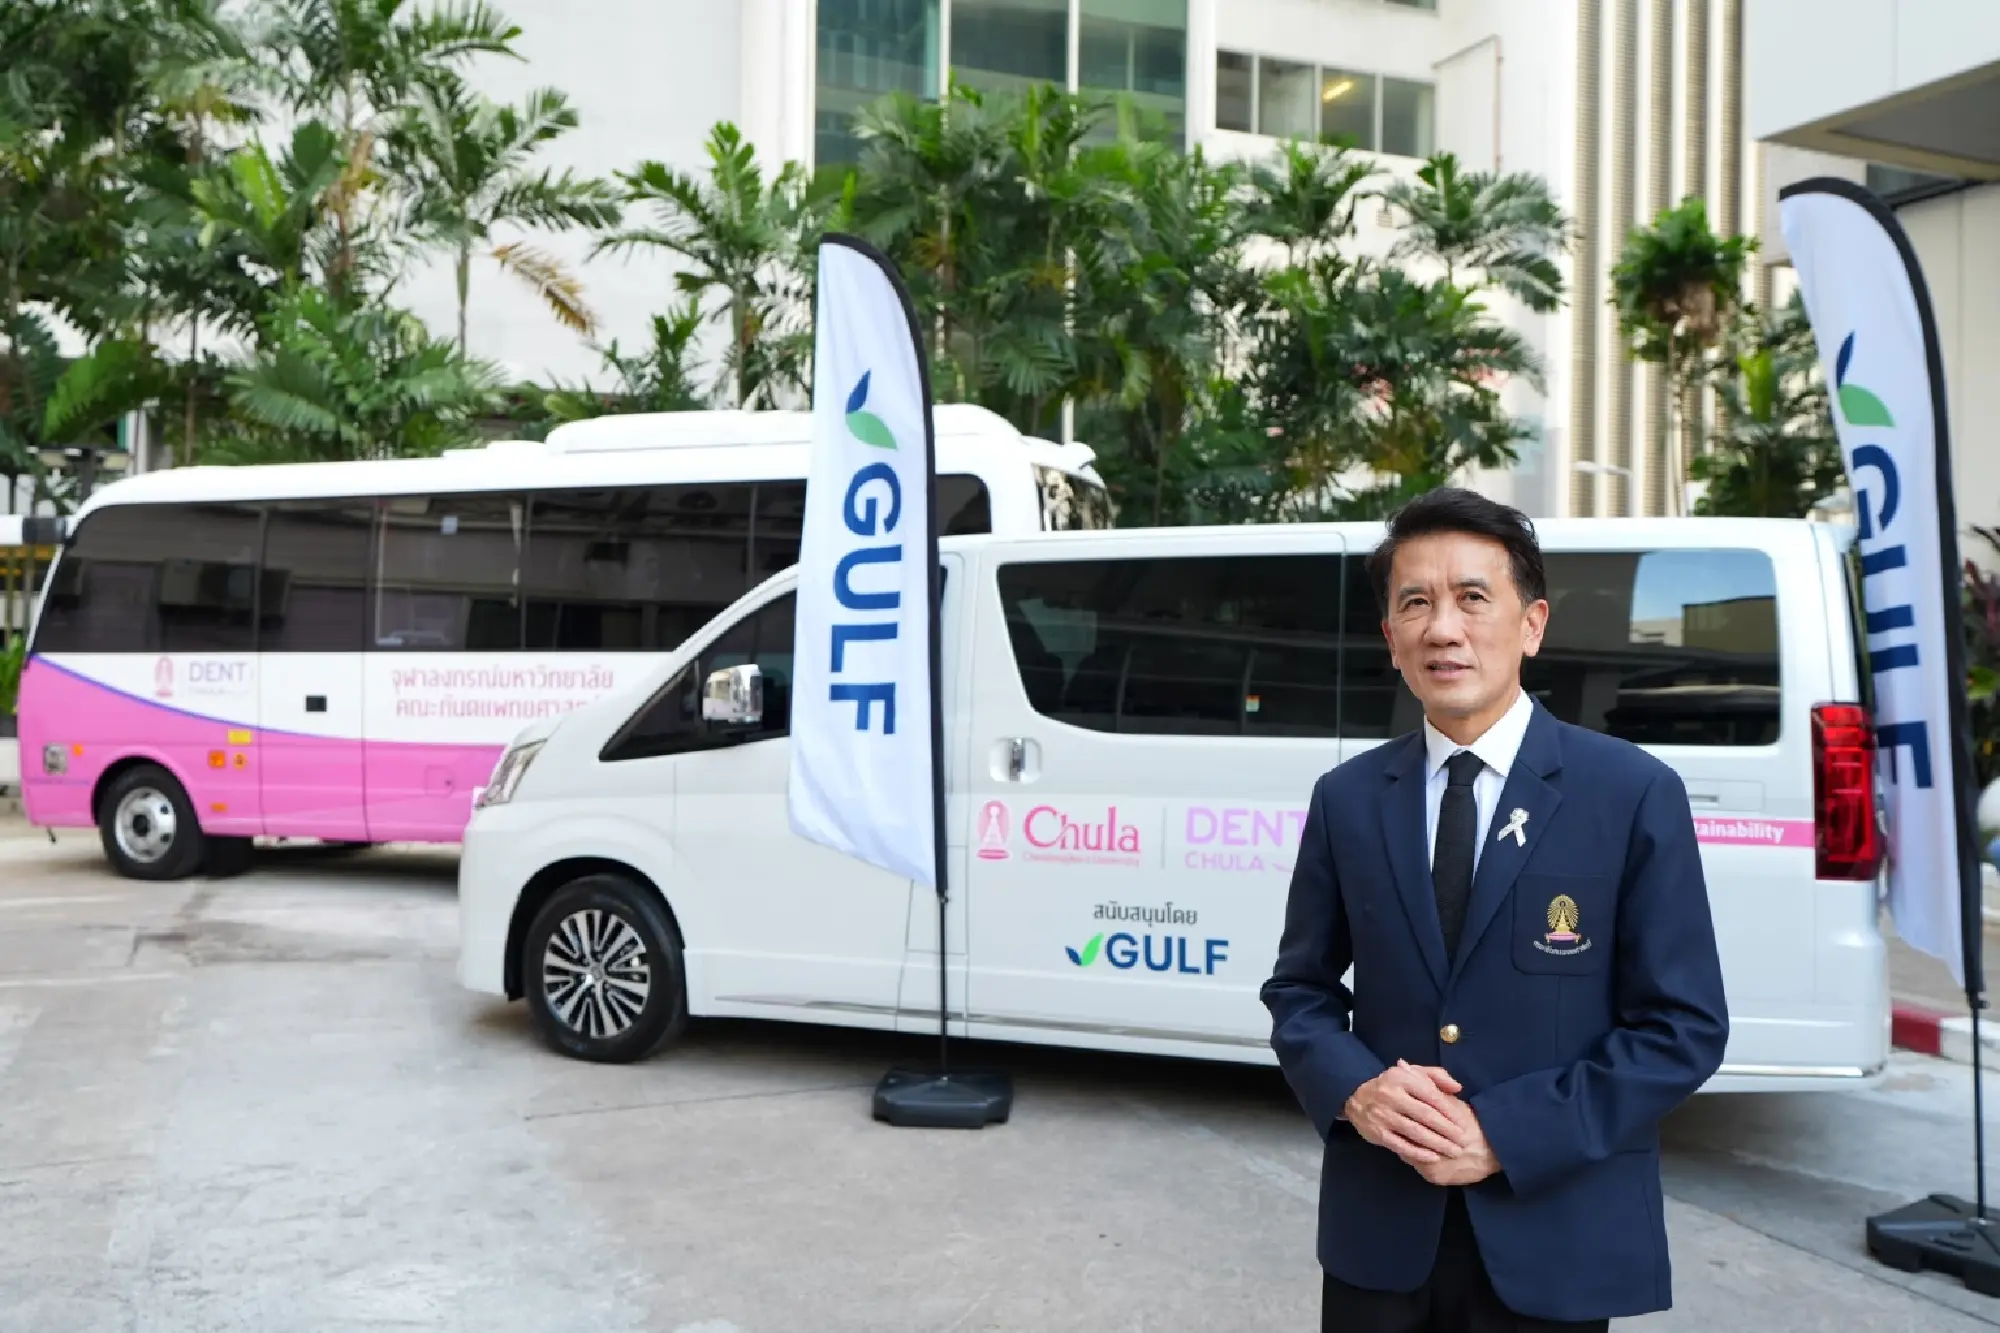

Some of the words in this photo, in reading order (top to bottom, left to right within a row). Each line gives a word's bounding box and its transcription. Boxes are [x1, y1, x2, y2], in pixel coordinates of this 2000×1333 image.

[828, 461, 902, 735] GULF
[189, 660, 248, 682] DENT
[392, 664, 615, 693] จุฬาลงกรณ์มหาวิทยาลัย
[1023, 804, 1141, 853] Chula
[1186, 806, 1308, 847] DENT
[1185, 850, 1265, 871] CHULA
[1093, 900, 1198, 927] สนับสนุนโดย
[1106, 932, 1229, 975] GULF
